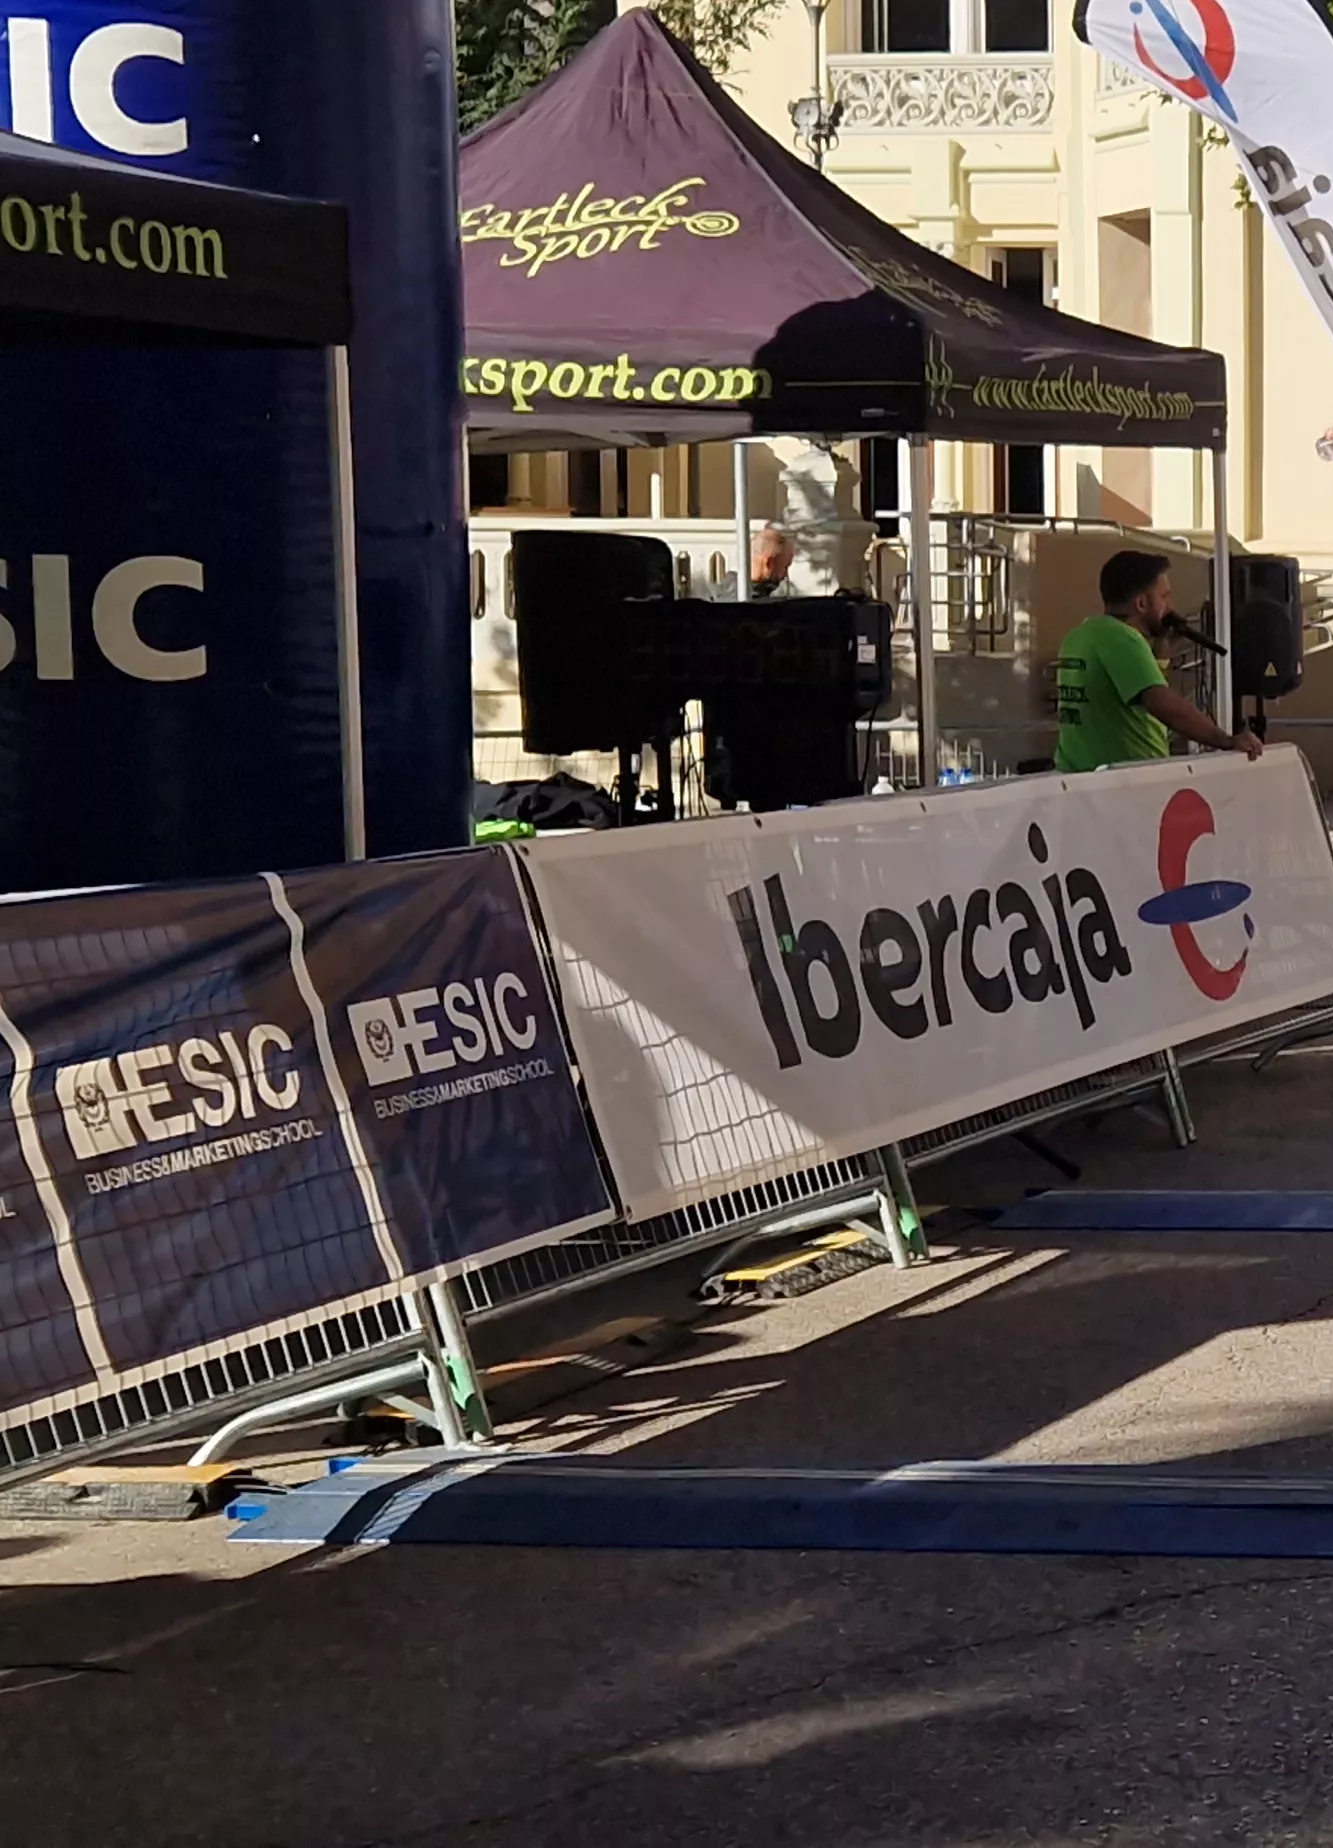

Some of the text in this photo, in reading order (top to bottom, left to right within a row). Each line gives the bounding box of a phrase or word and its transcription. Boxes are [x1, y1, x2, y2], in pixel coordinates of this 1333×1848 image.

[499, 215, 671, 278] Sport
[973, 363, 1194, 431] www.fartlecksport.com
[0, 553, 208, 682] IC
[727, 822, 1131, 1069] Ibercaja
[396, 972, 537, 1074] ESIC
[117, 1024, 300, 1142] ESIC
